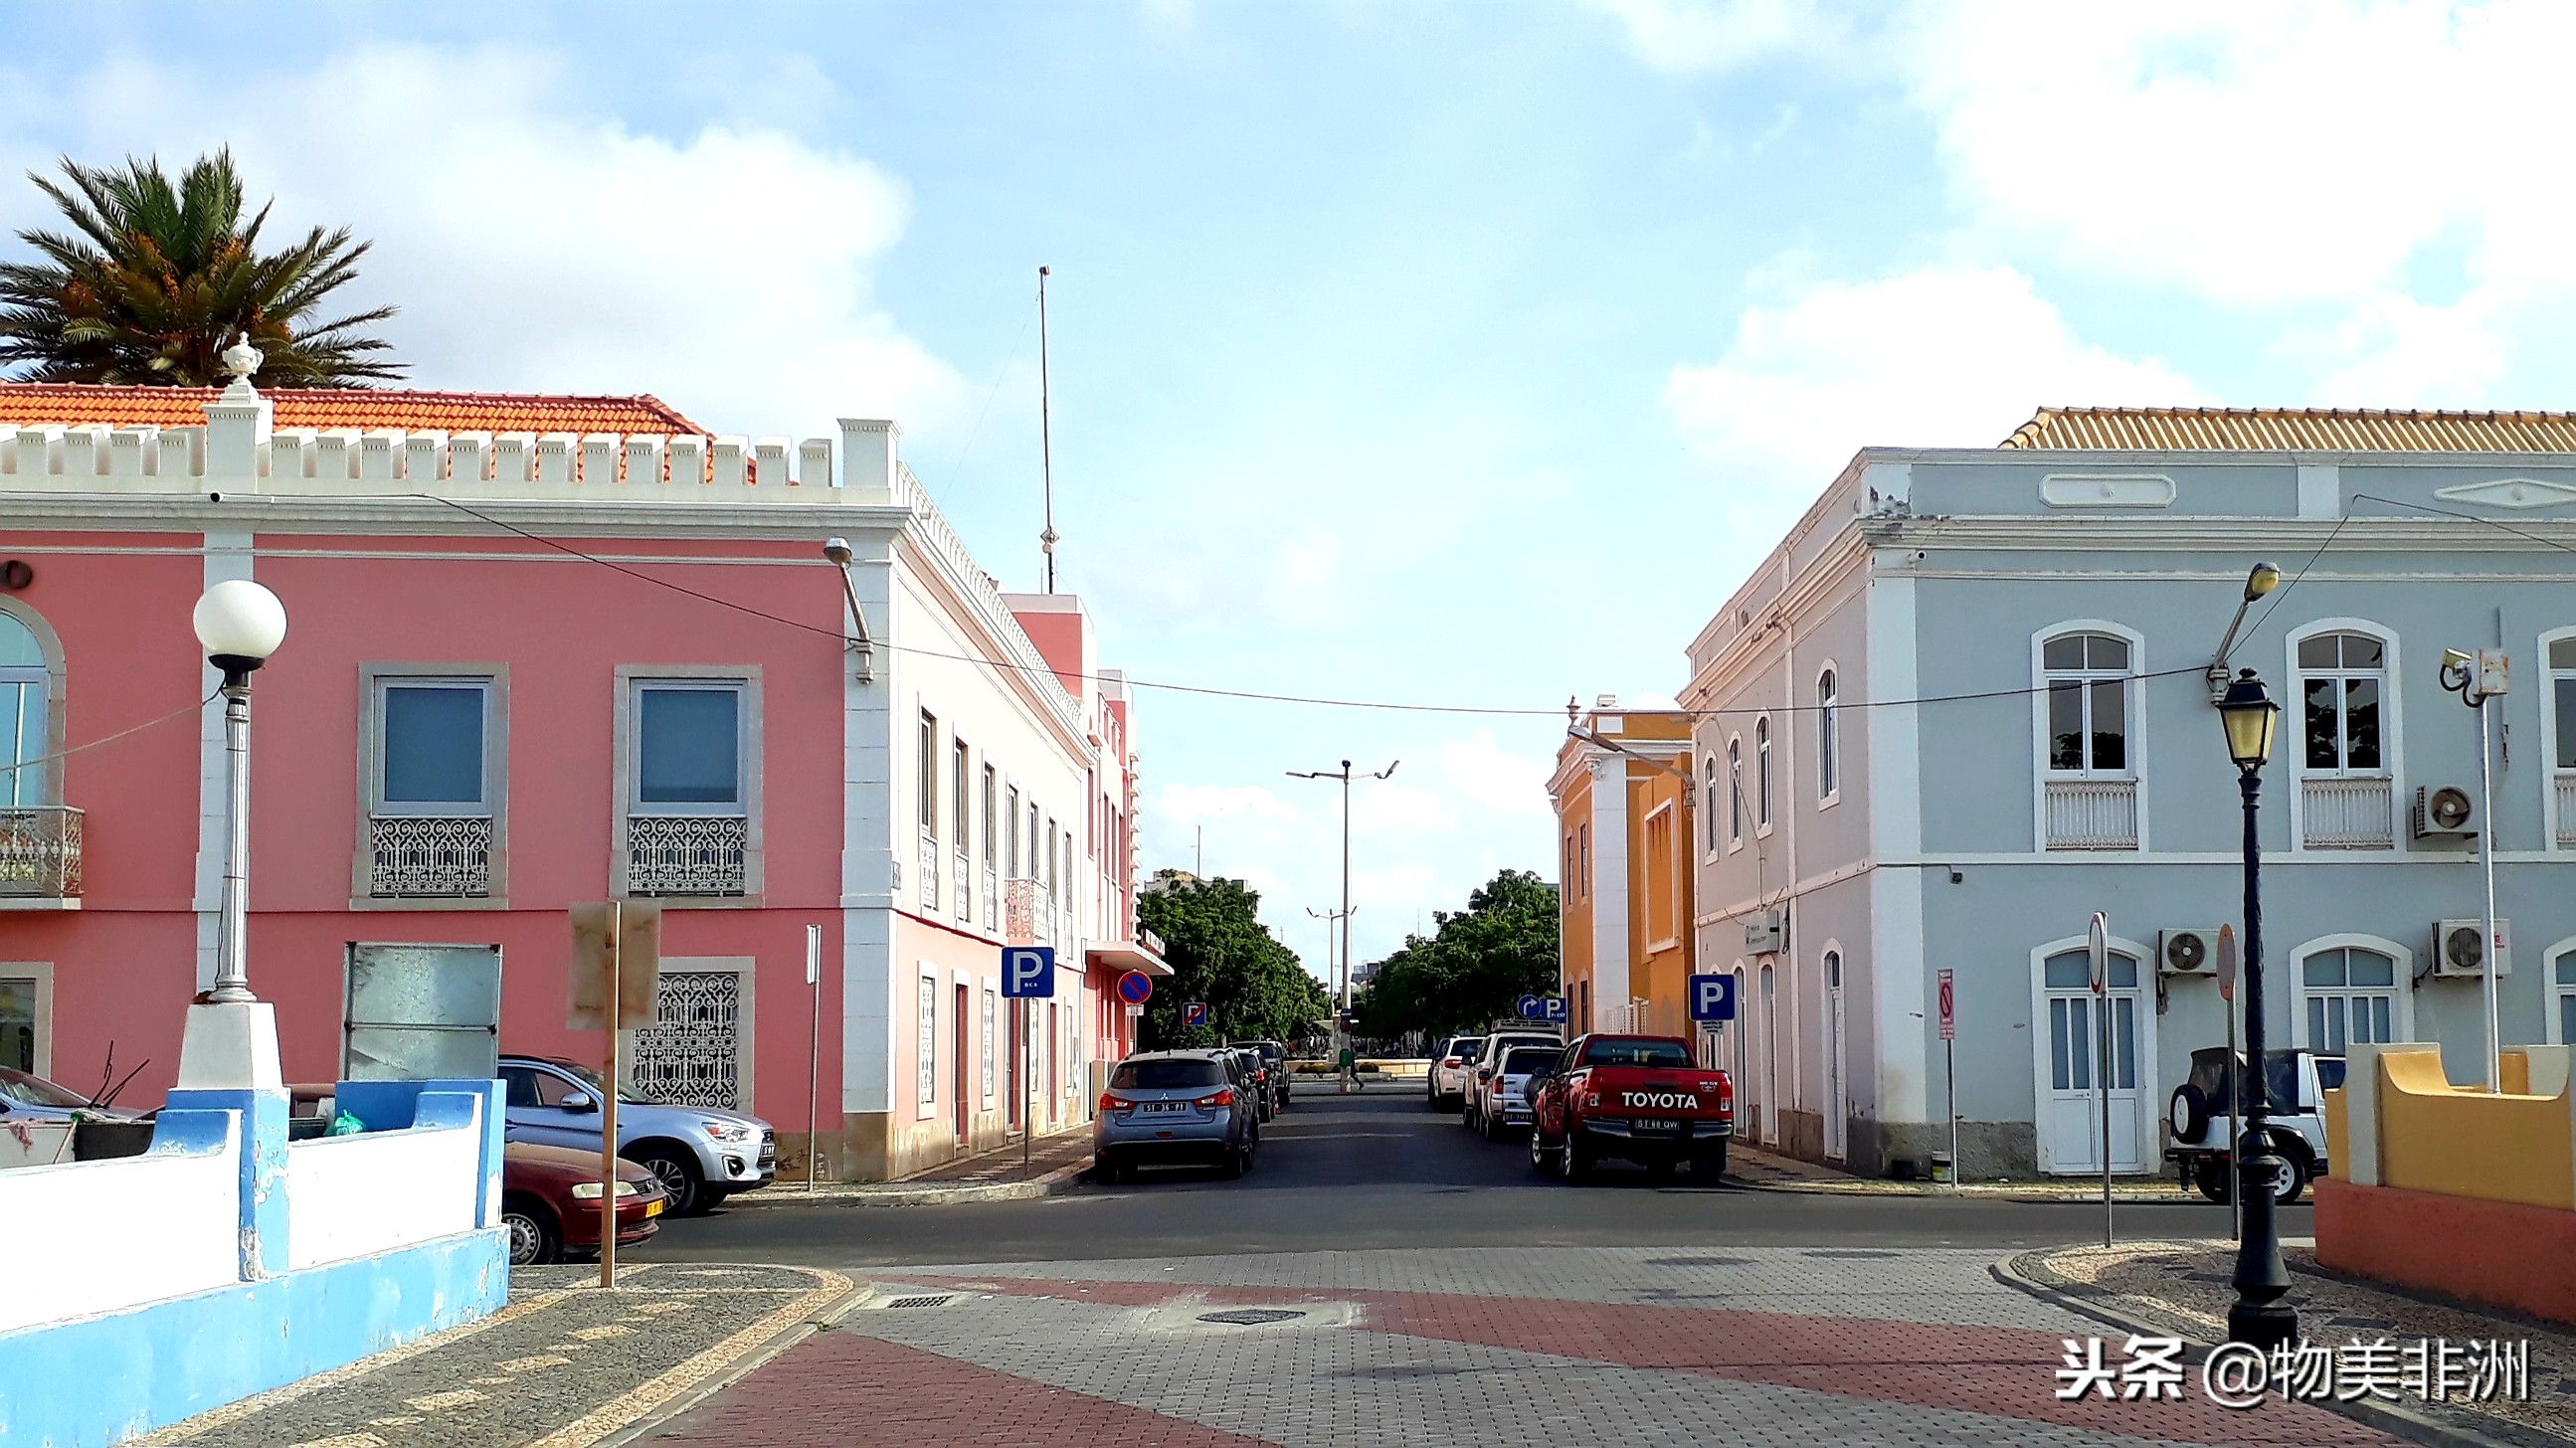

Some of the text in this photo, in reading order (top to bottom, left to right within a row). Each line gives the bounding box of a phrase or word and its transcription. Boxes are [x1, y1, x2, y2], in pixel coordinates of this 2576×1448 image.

[1012, 951, 1043, 993] P
[1546, 998, 1562, 1018] P
[1700, 982, 1724, 1013] P
[1621, 1091, 1699, 1110] TOYOTA
